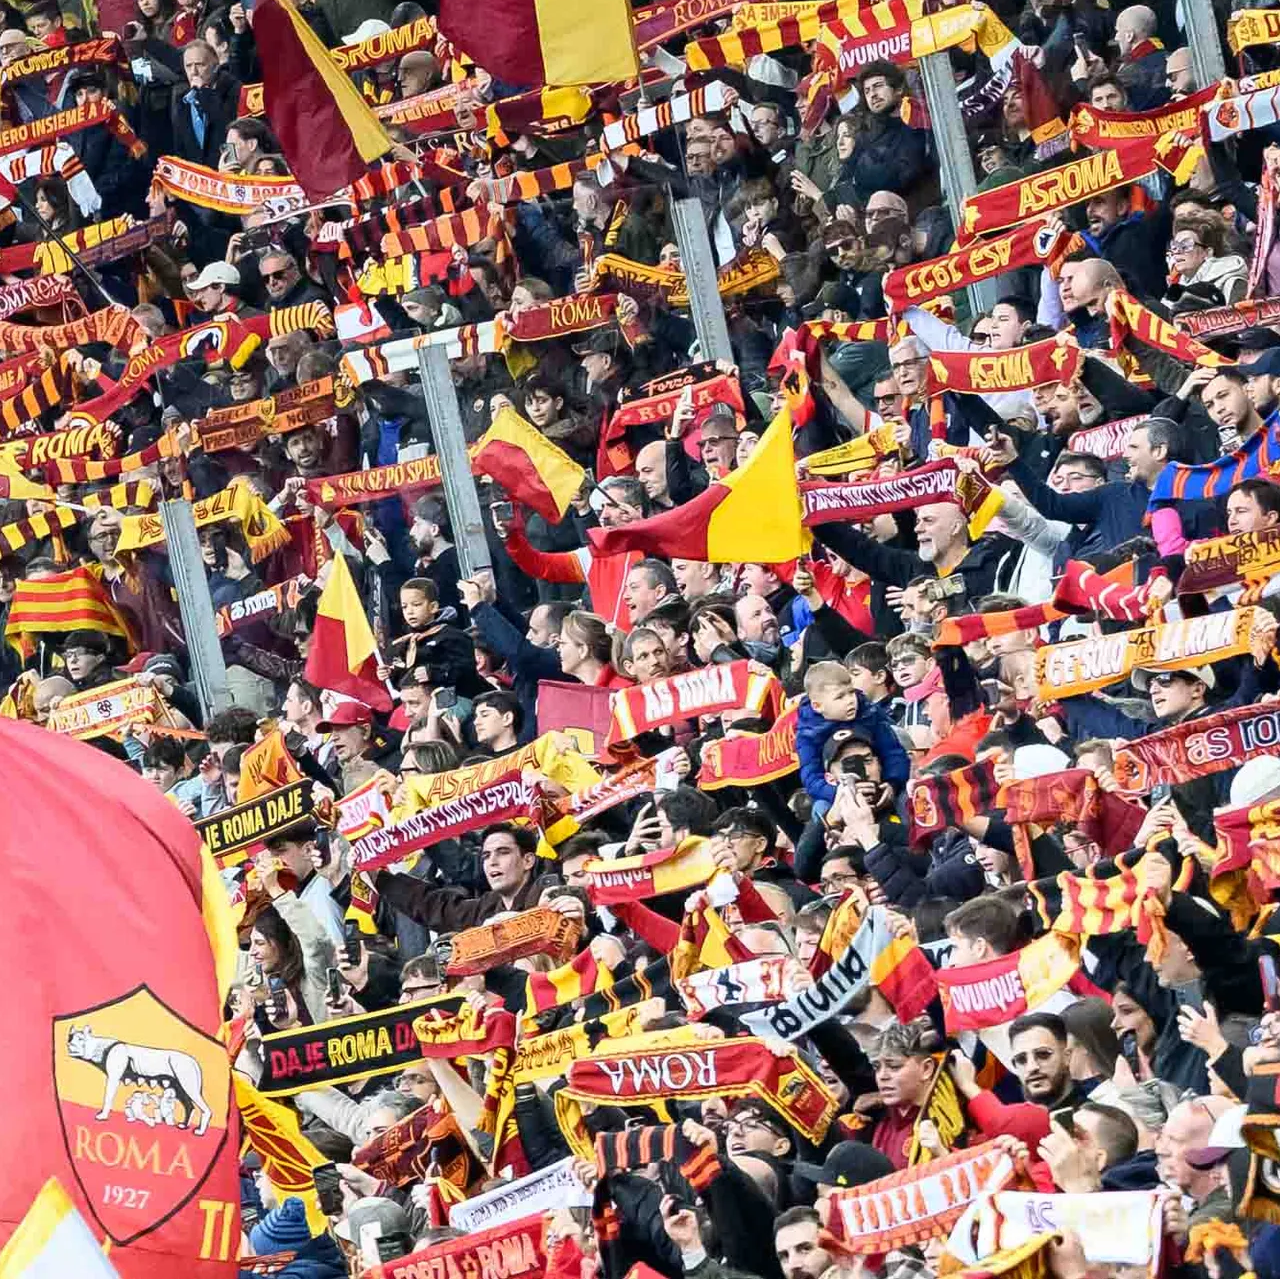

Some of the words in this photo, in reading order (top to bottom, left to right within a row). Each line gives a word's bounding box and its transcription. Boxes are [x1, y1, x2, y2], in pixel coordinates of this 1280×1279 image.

[838, 32, 911, 74] OVUNQUE
[31, 108, 82, 141] INSIEME
[179, 169, 230, 200] FORZA
[1018, 148, 1123, 216] ASROMA
[905, 251, 963, 300] 1927
[970, 240, 1011, 288] ASR
[550, 295, 603, 329] ROMA
[120, 344, 166, 389] ROMA
[970, 346, 1034, 389] ASROMA
[29, 426, 104, 468] ROMA
[339, 471, 368, 497] NUN
[370, 467, 388, 491] SE
[1082, 633, 1123, 679] SOLO
[645, 680, 672, 721] AS
[677, 667, 736, 715] ROMA
[1186, 719, 1230, 760] as
[223, 803, 263, 842] ROMA
[265, 788, 304, 828] DAJE
[950, 969, 1024, 1014] OVUNQUE
[271, 1038, 323, 1081] DAJE
[327, 1025, 392, 1069] ROMA
[599, 1051, 718, 1092] ROMA
[73, 1125, 195, 1179] ROMA
[103, 1185, 150, 1211] 1927
[479, 1231, 539, 1275] ROMA
